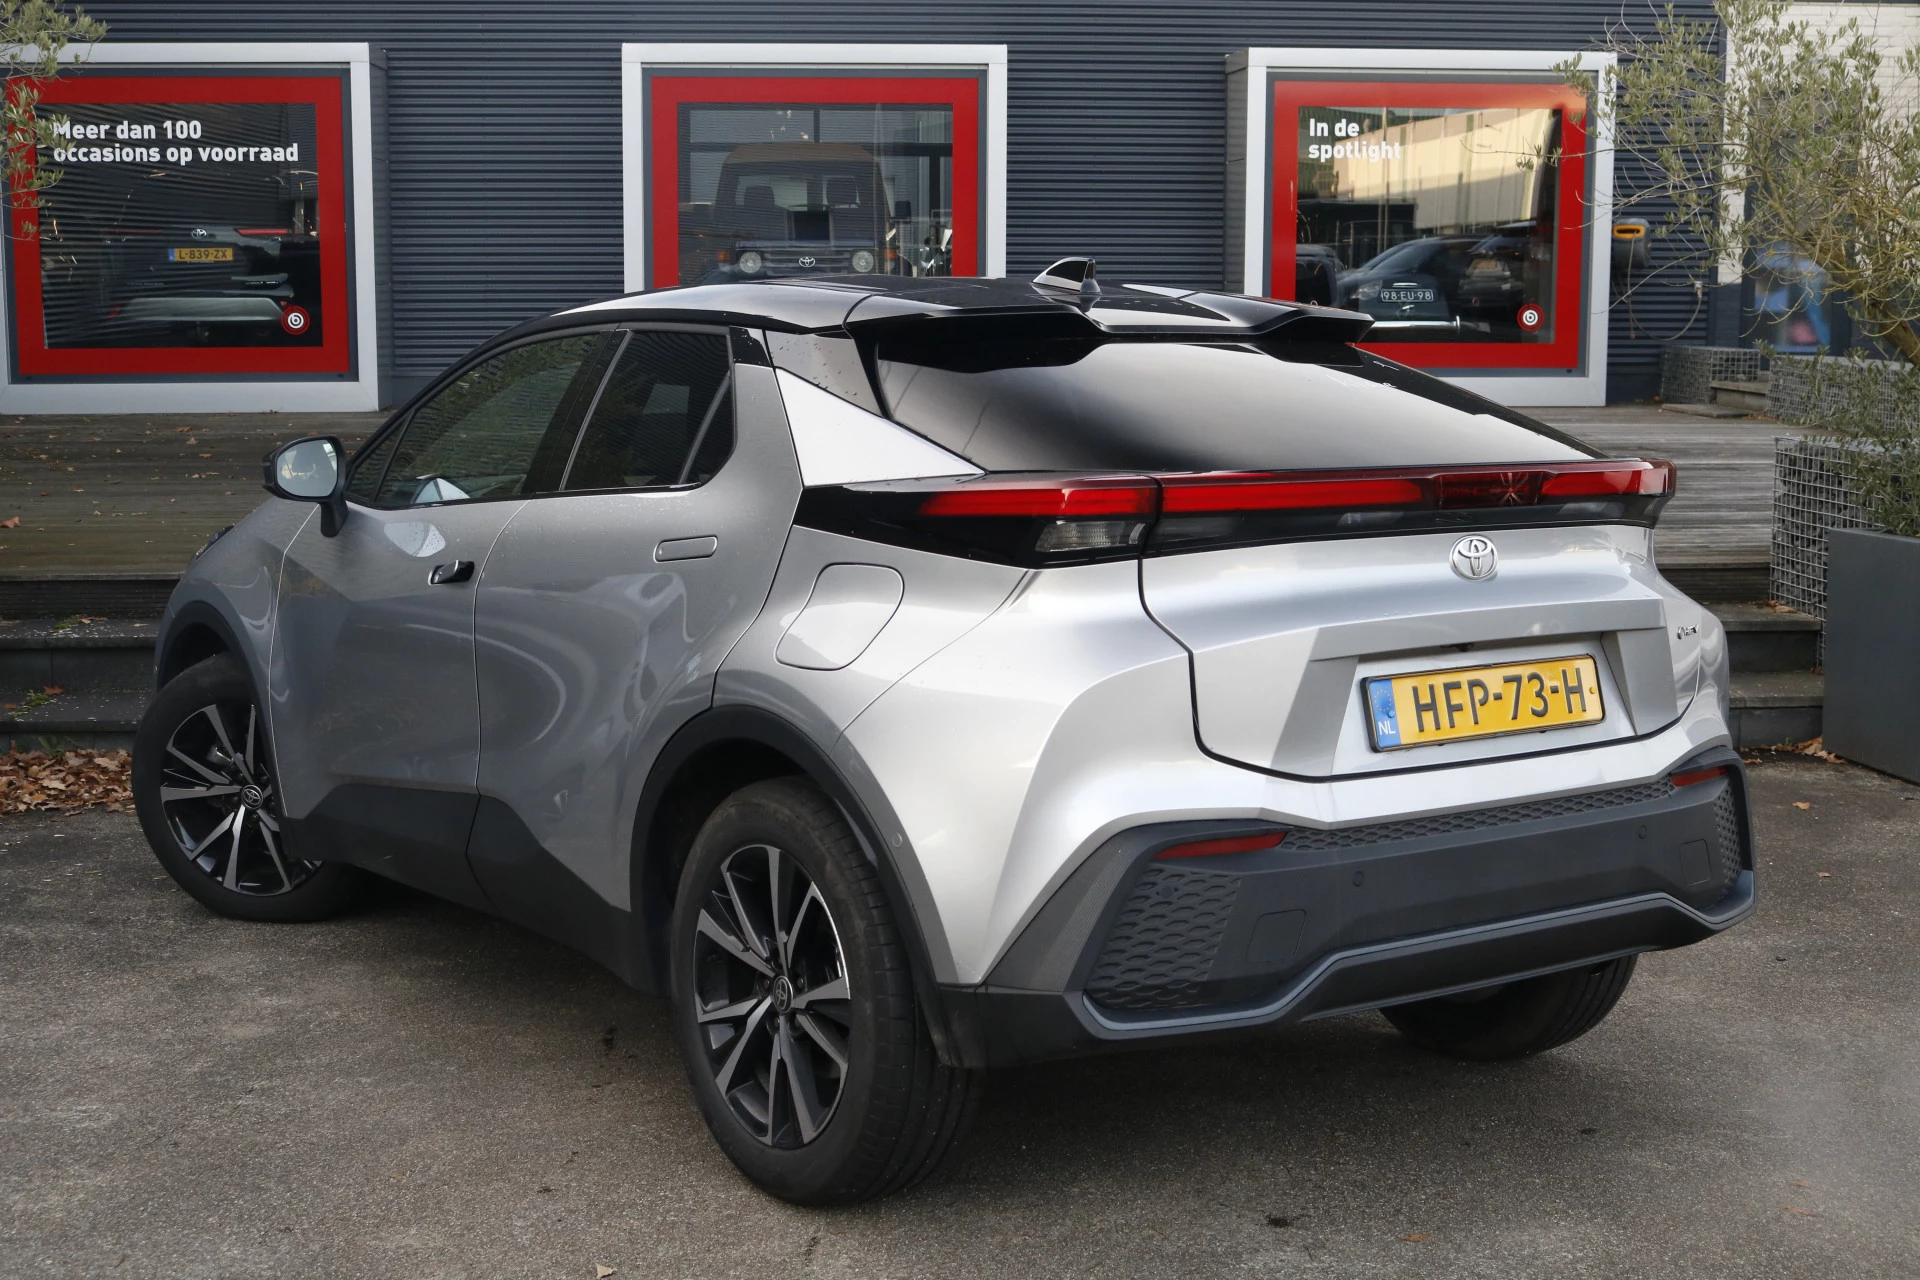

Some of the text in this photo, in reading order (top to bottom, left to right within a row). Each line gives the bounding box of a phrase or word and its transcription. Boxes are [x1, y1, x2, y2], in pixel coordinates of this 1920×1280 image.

[53, 121, 202, 139] Meer dan 100
[1309, 118, 1360, 136] In de
[53, 143, 299, 165] occasions op voorraad
[1308, 141, 1402, 163] spotlight
[178, 249, 229, 260] L-839-ZX
[1411, 667, 1588, 733] HFP-73-H
[1378, 720, 1396, 736] NL
